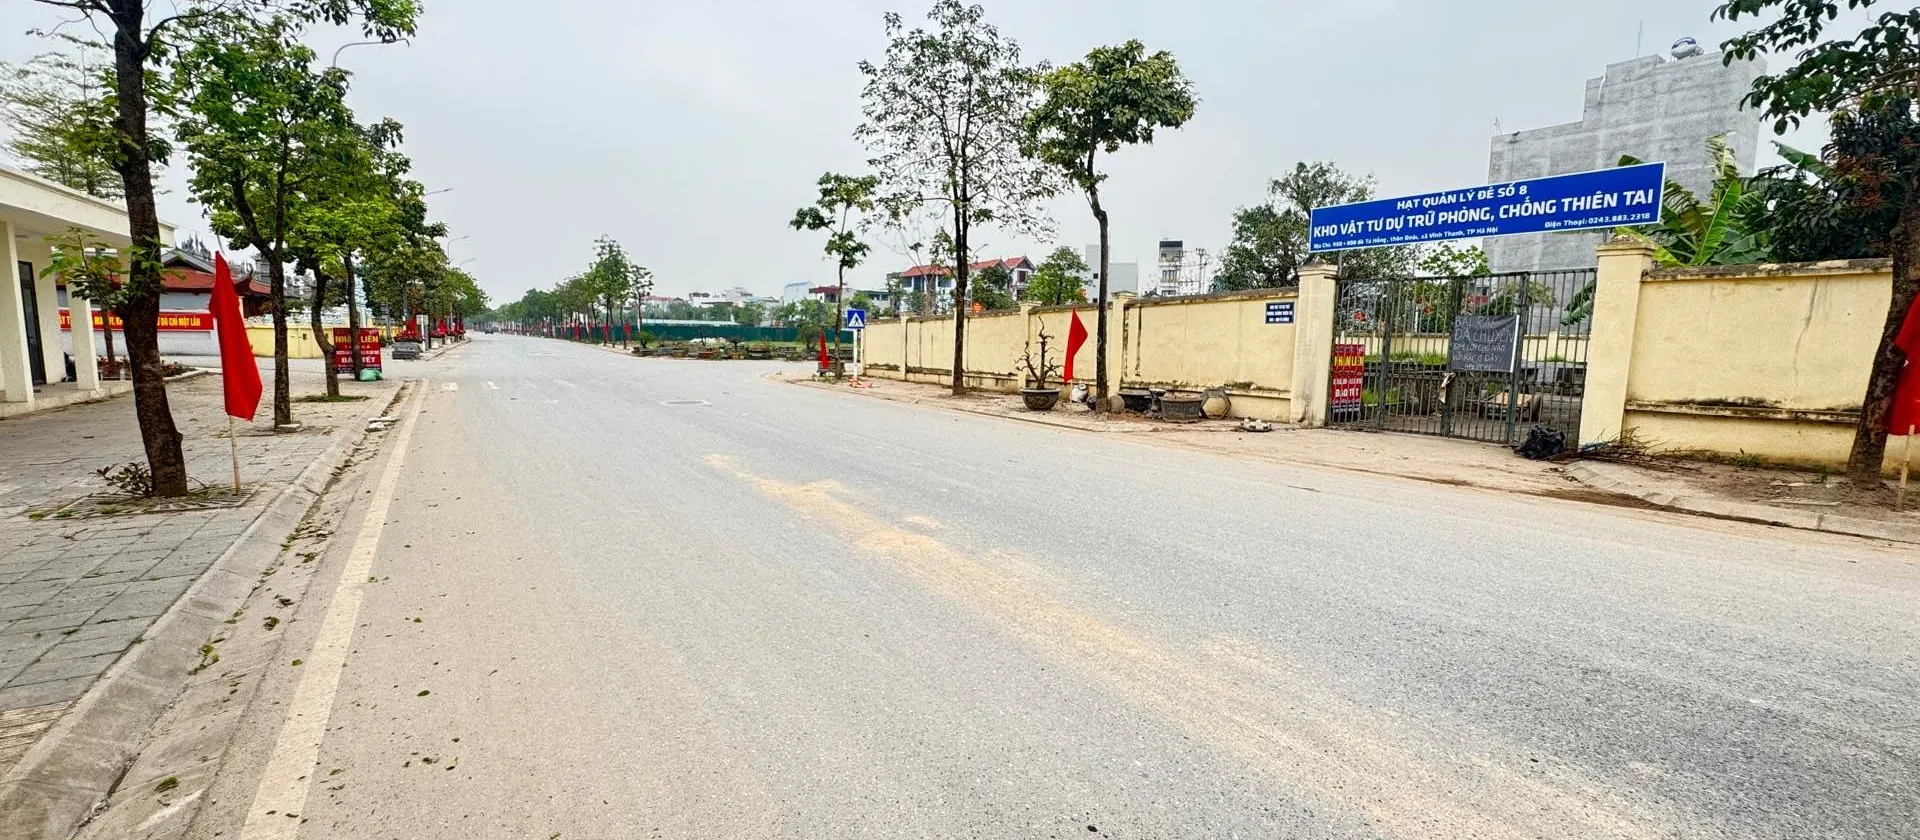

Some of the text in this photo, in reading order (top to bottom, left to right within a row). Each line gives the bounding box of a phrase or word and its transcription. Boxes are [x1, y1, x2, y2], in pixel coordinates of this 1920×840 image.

[1313, 189, 1654, 238] KHO VẬT TƯ DỰ TRỮ PHÒNG, CHỐNG THIÊN TAI
[1397, 182, 1527, 211] HẠT QUẢN LÝ ĐÊ SỐ 8
